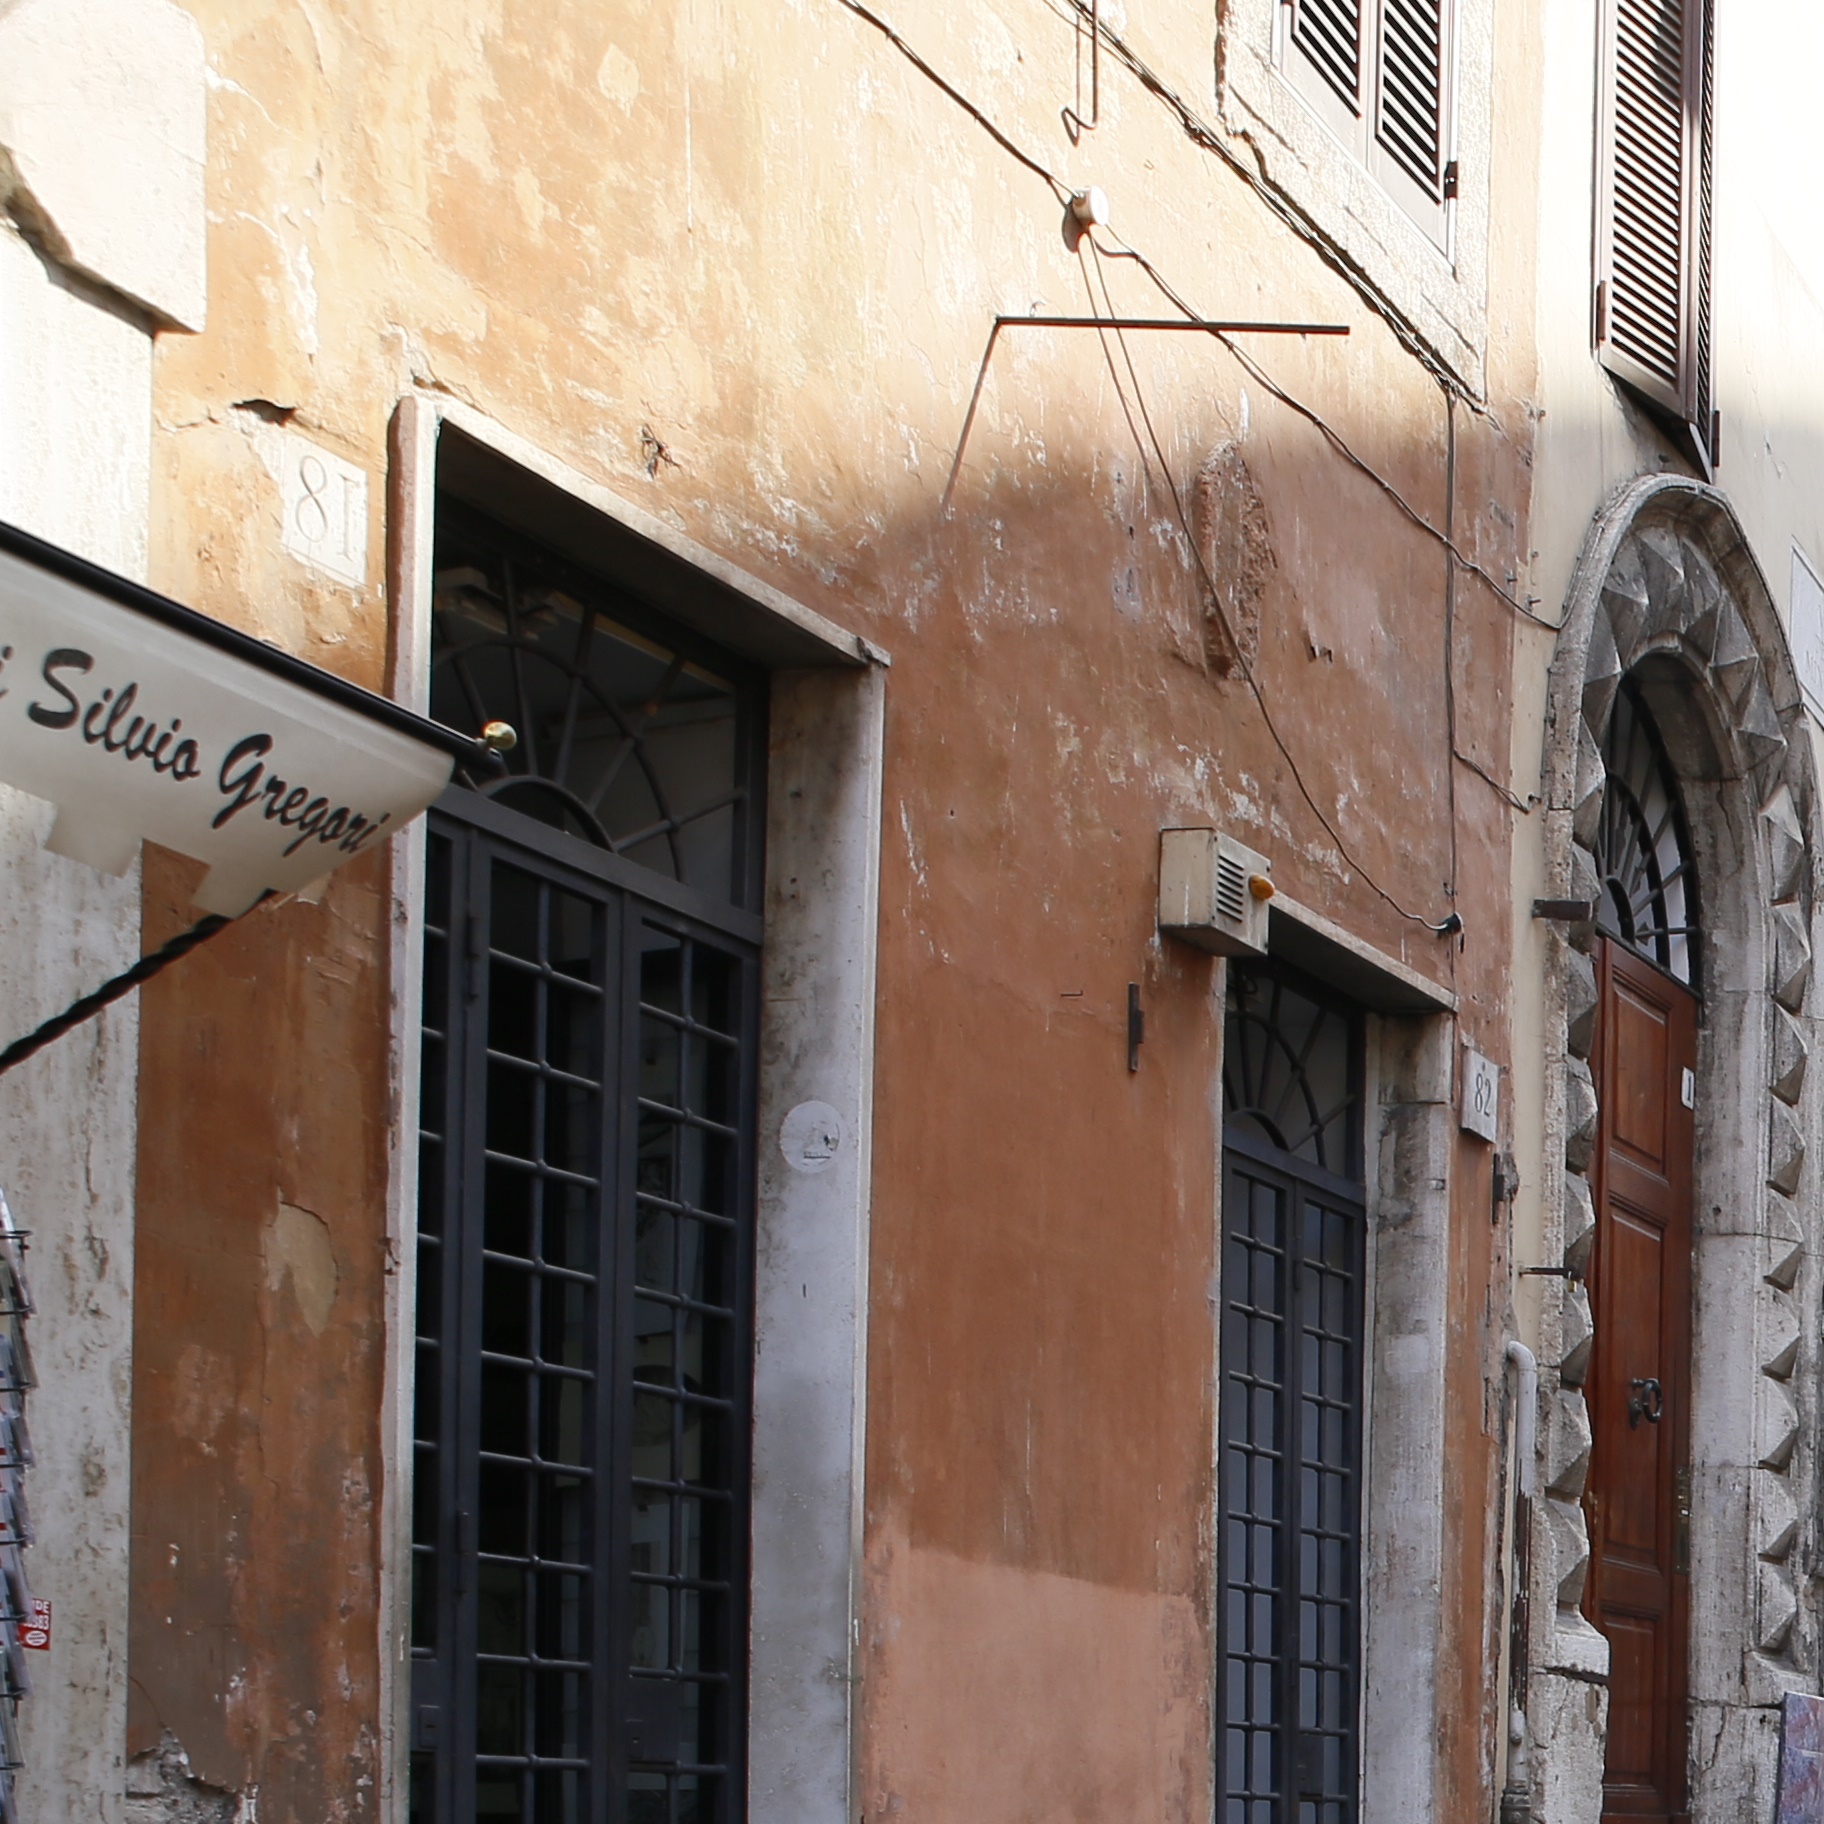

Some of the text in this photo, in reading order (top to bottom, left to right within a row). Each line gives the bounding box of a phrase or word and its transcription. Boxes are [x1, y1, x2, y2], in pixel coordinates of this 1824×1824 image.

[295, 454, 361, 562] 81
[28, 648, 201, 782] Silvio
[212, 733, 391, 858] Gregori
[1475, 1073, 1491, 1118] 82
